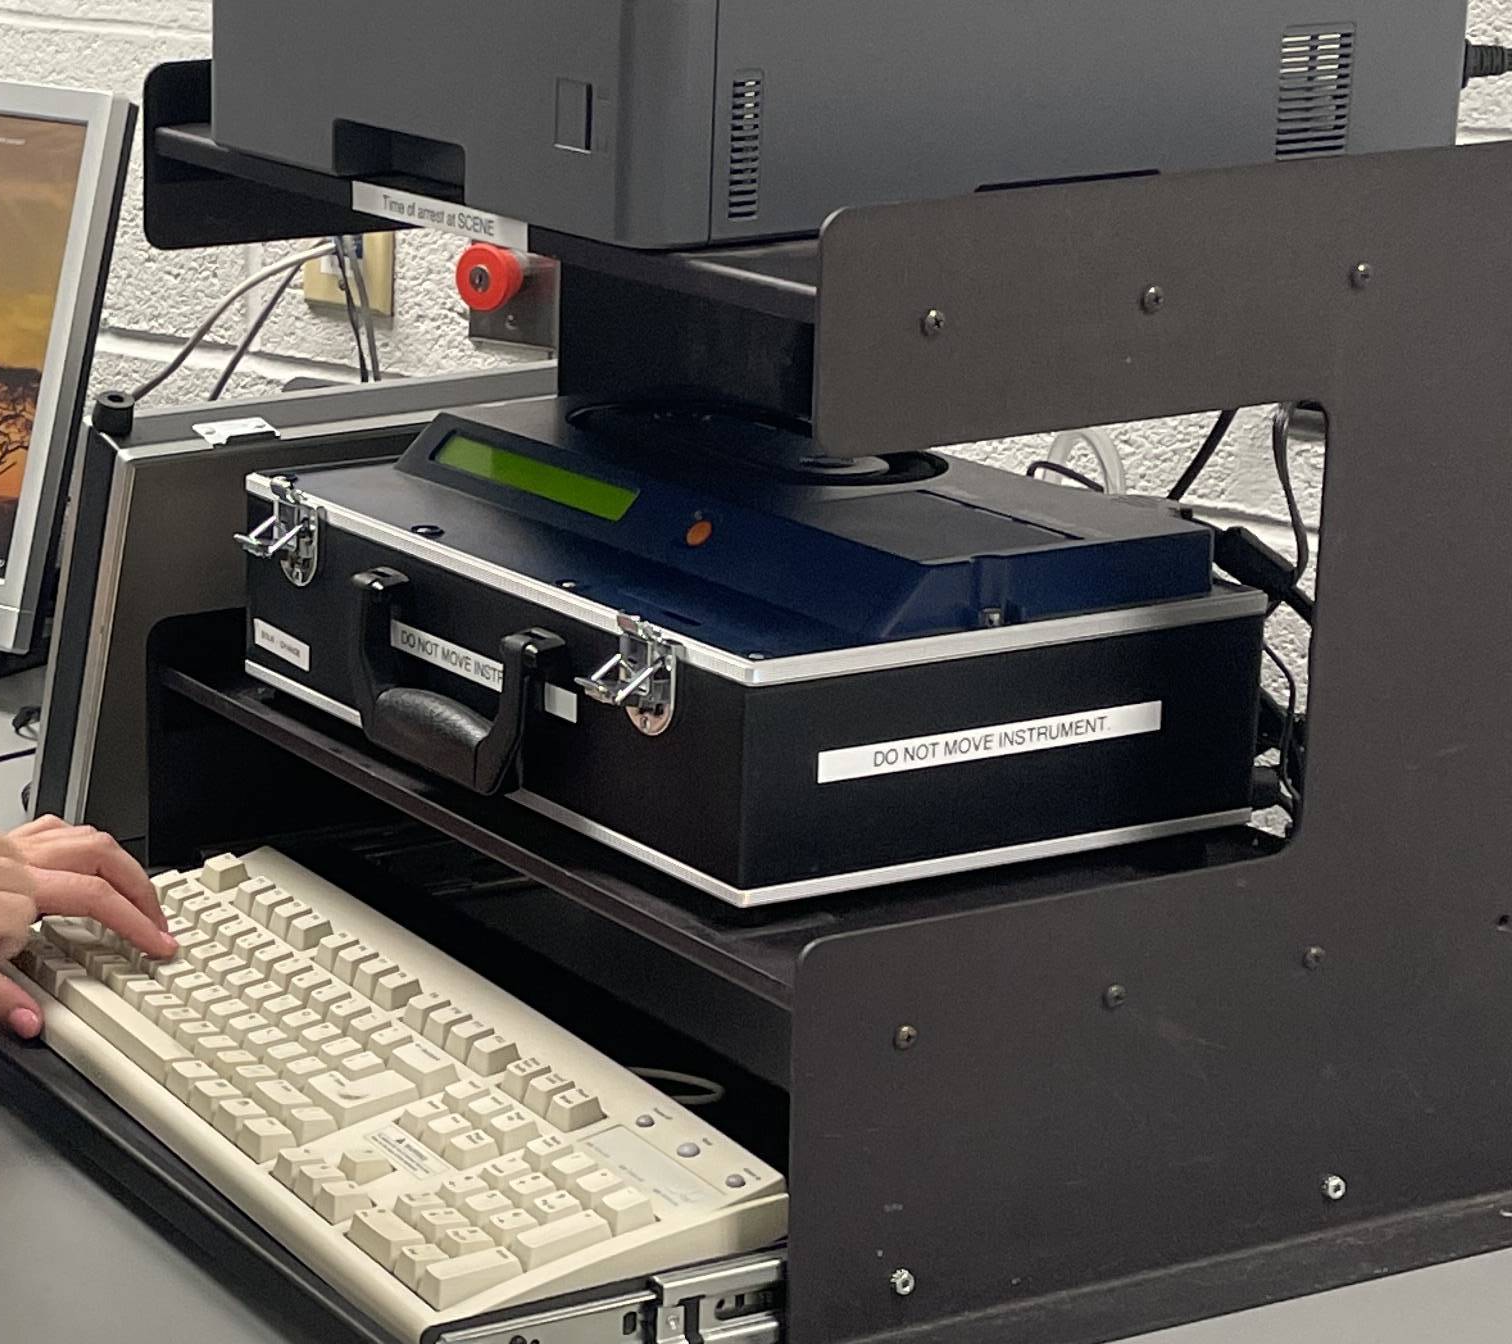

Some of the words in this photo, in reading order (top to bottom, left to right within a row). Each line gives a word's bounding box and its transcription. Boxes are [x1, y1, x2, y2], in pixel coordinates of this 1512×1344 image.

[382, 194, 405, 214] Time
[406, 202, 416, 215] of
[417, 207, 445, 224] arrest
[446, 213, 456, 227] at
[457, 213, 495, 236] SCENE
[401, 630, 416, 649] DO
[418, 639, 439, 657] NOT
[441, 647, 472, 672] MOVE
[873, 748, 898, 768] DO
[903, 741, 939, 762] NOT
[943, 733, 993, 757] MOVE
